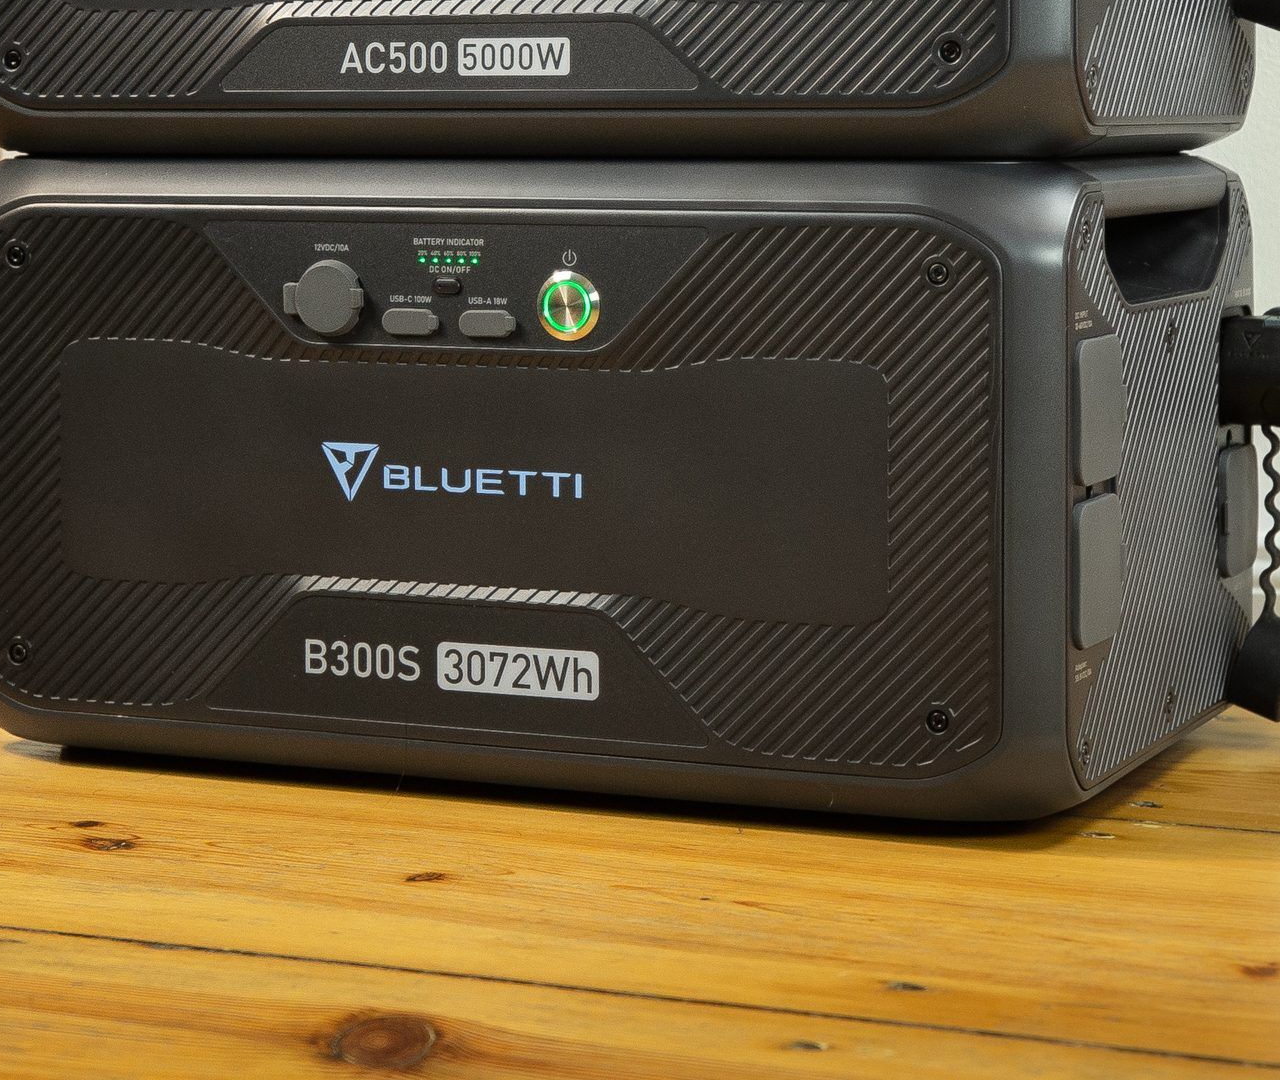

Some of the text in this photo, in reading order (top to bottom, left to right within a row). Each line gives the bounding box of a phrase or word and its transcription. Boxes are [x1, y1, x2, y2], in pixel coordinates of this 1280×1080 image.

[340, 42, 448, 74] AC500
[462, 42, 565, 71] 5000W
[413, 237, 485, 246] BATTERY INDICATOR
[429, 265, 471, 274] DC ON/OFF
[389, 294, 432, 303] USB-C 100W
[468, 296, 492, 305] USB-A
[383, 464, 583, 499] BLUETTI
[305, 638, 421, 682] B300S
[443, 648, 593, 694] 3072Wh
